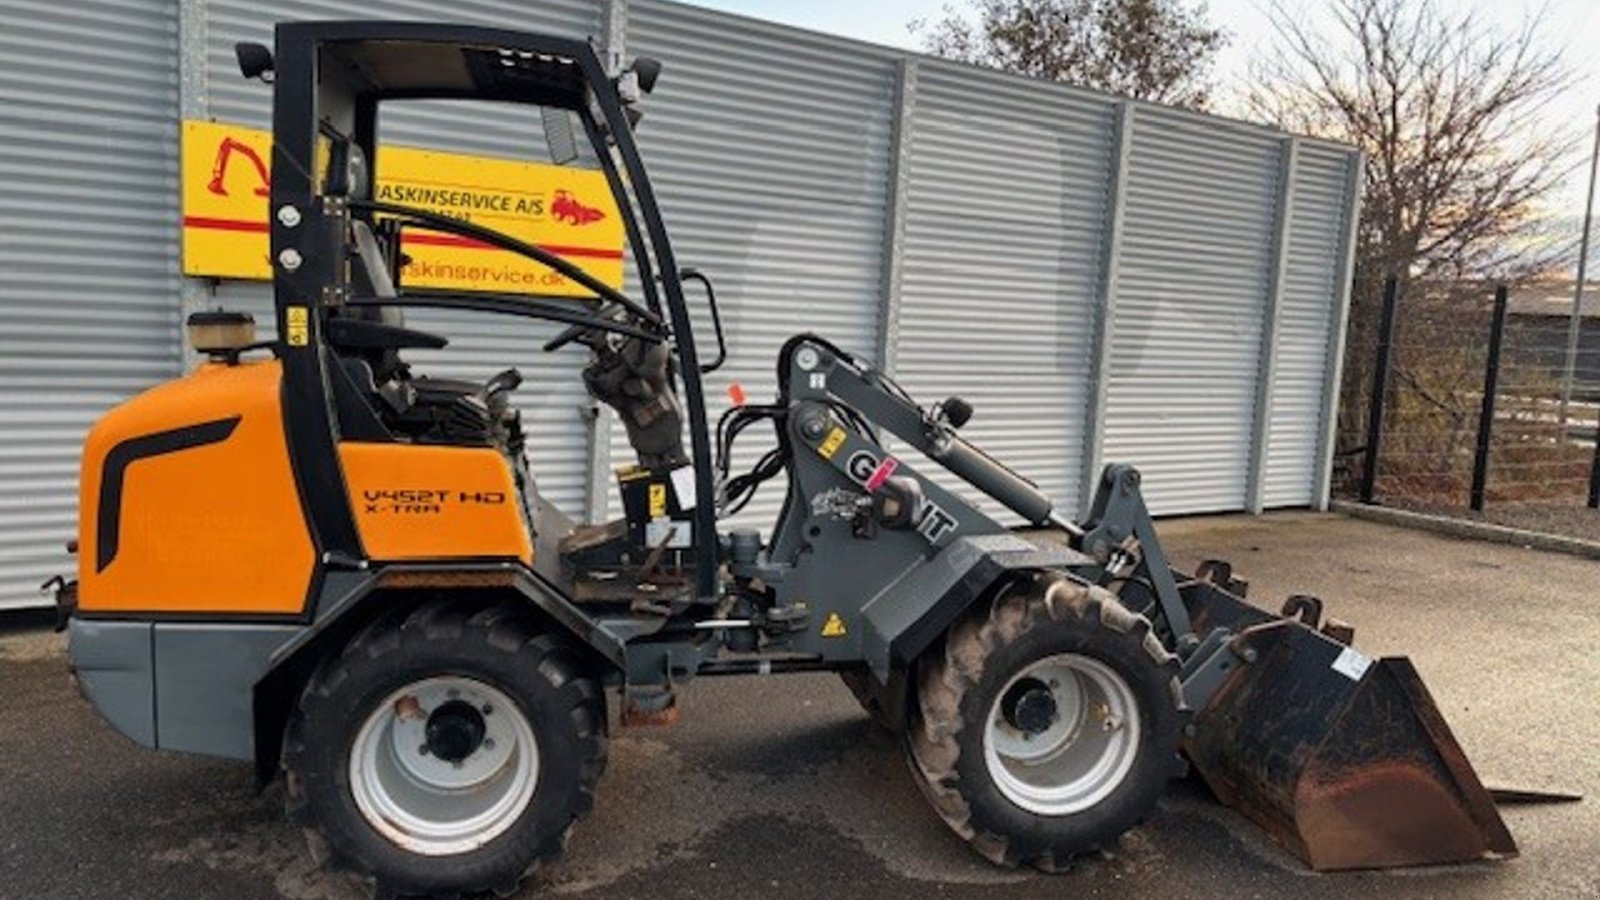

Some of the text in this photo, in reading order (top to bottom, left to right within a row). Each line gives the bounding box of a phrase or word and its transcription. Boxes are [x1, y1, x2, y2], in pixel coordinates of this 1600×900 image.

[375, 184, 544, 216] ASKINSERVICE A/S
[364, 490, 506, 504] V452T HD
[846, 450, 958, 544] GIT
[364, 504, 441, 514] X-TRA
